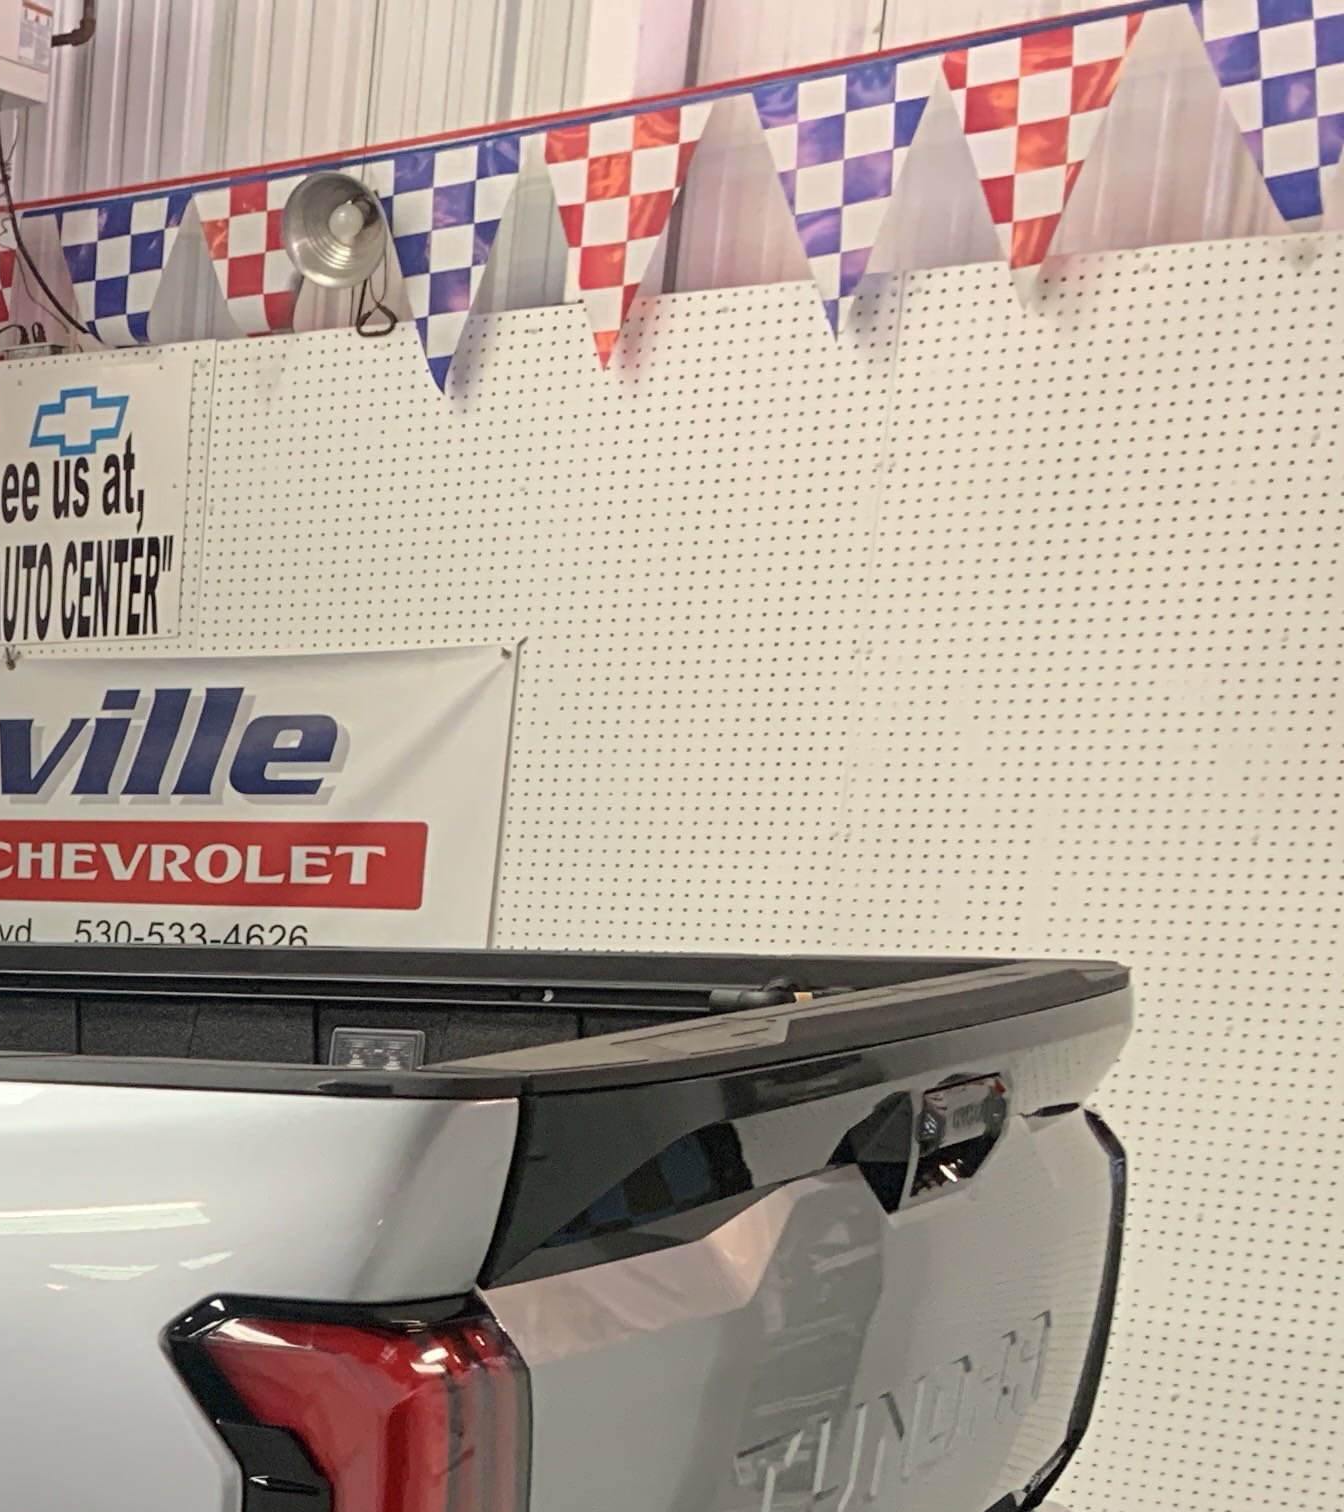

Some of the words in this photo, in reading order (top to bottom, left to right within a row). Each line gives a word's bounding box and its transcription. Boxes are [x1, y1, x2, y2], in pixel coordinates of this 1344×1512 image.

[53, 456, 90, 519] us
[102, 431, 145, 534] at,
[62, 535, 174, 640] CENTER"
[74, 919, 309, 945] 530-533-4626
